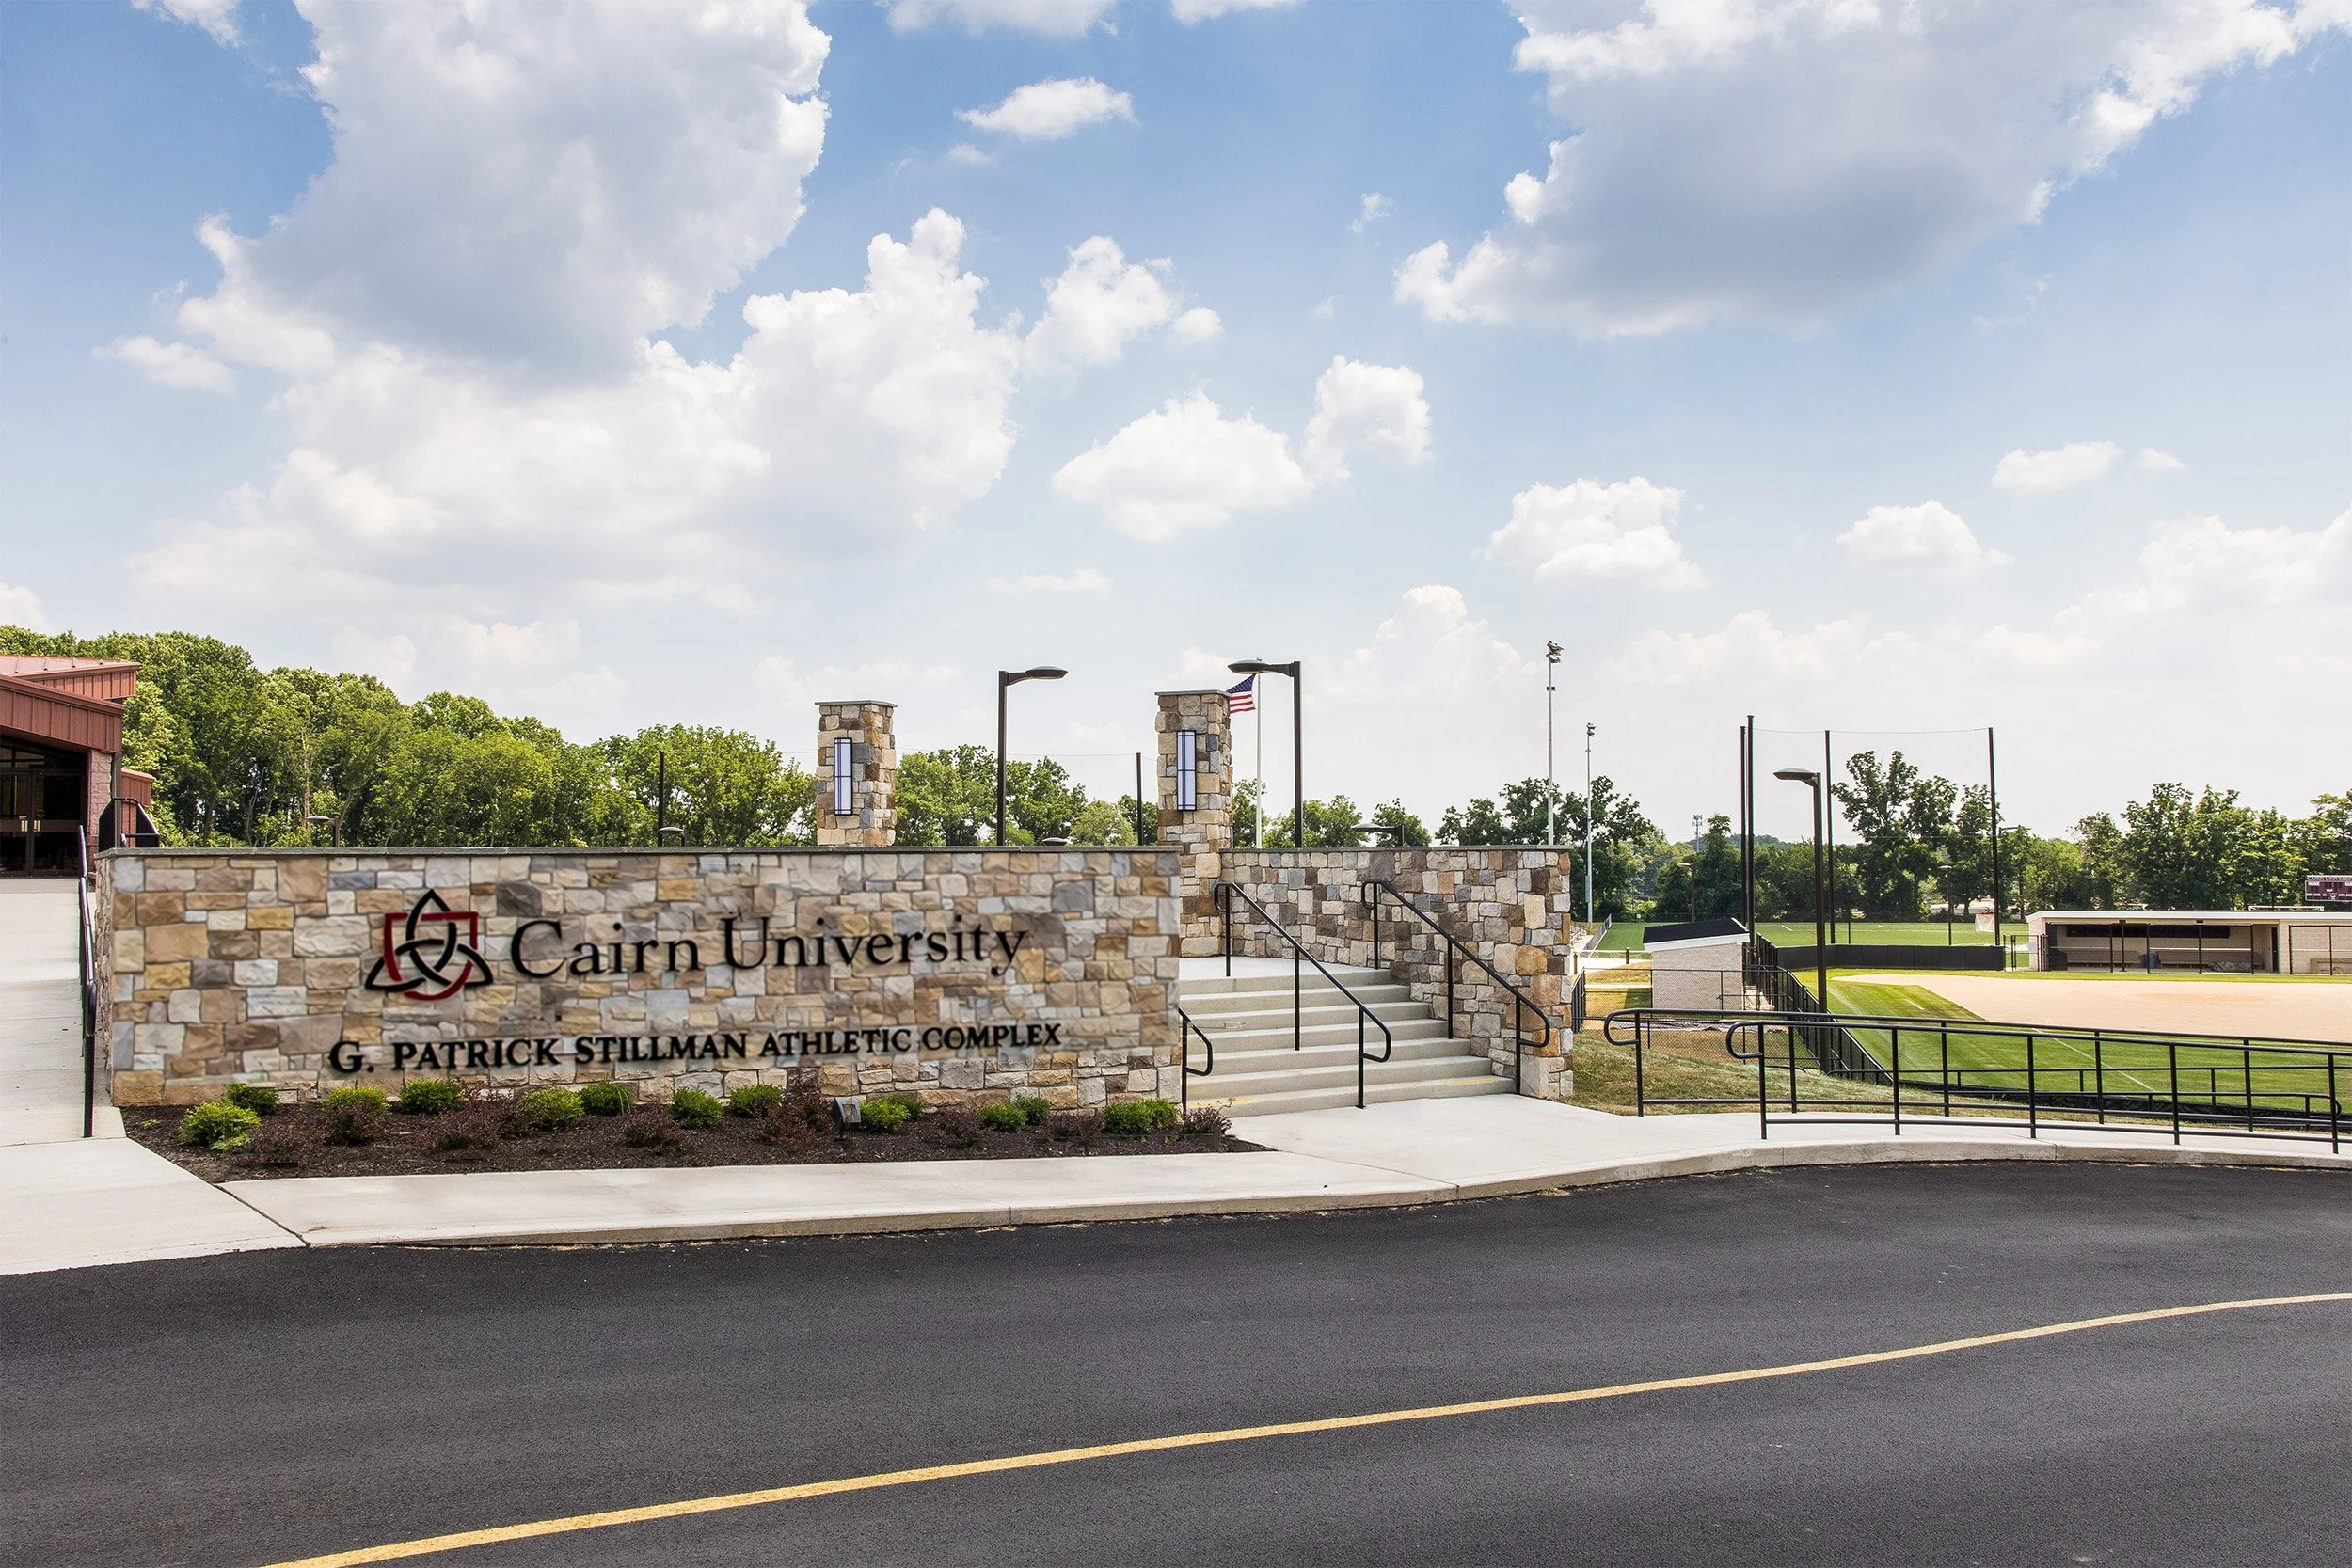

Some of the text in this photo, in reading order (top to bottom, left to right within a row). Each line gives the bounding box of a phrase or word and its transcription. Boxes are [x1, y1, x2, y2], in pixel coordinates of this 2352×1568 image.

[511, 913, 1026, 978] Cairn University
[329, 1022, 1061, 1073] G. PATRICK STILLMAN ATHLETIC COMPLEX
